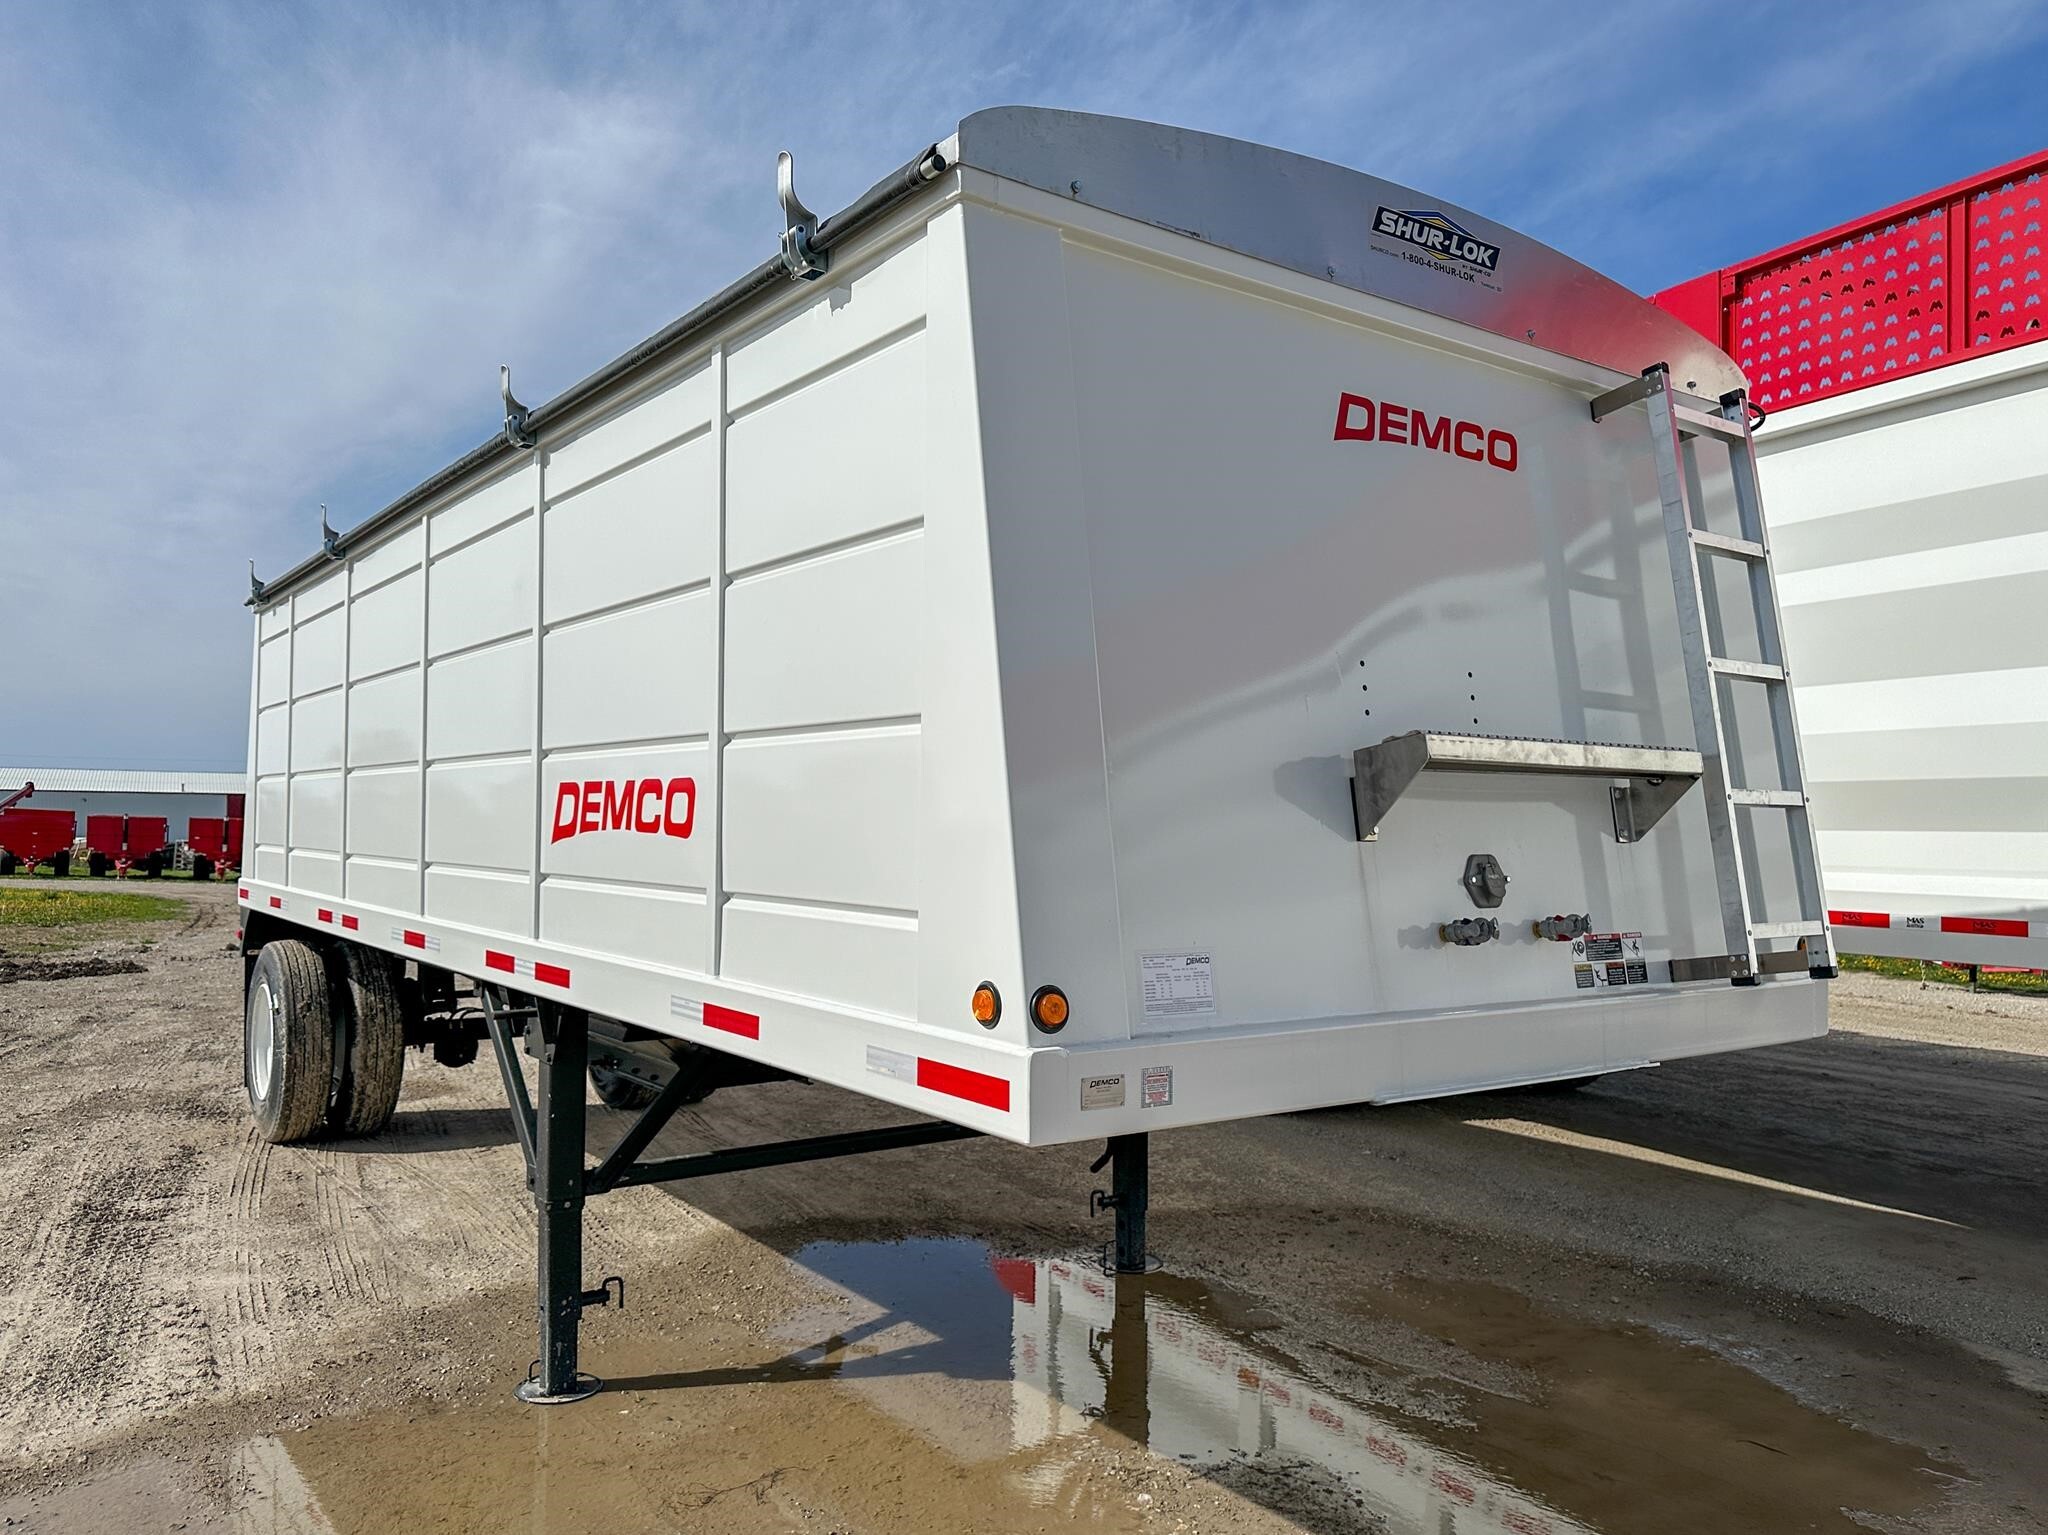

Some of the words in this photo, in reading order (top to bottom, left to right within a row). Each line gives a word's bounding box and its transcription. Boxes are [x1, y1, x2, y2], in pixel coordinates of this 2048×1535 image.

[1379, 210, 1494, 267] SHUR-LOK
[1401, 251, 1475, 283] 1-800-4-SHUR-LOK
[1333, 391, 1518, 473] DEMCO
[550, 776, 696, 846] DEMCO
[1186, 956, 1210, 966] DEMCO
[1089, 1078, 1120, 1089] DEMCO
